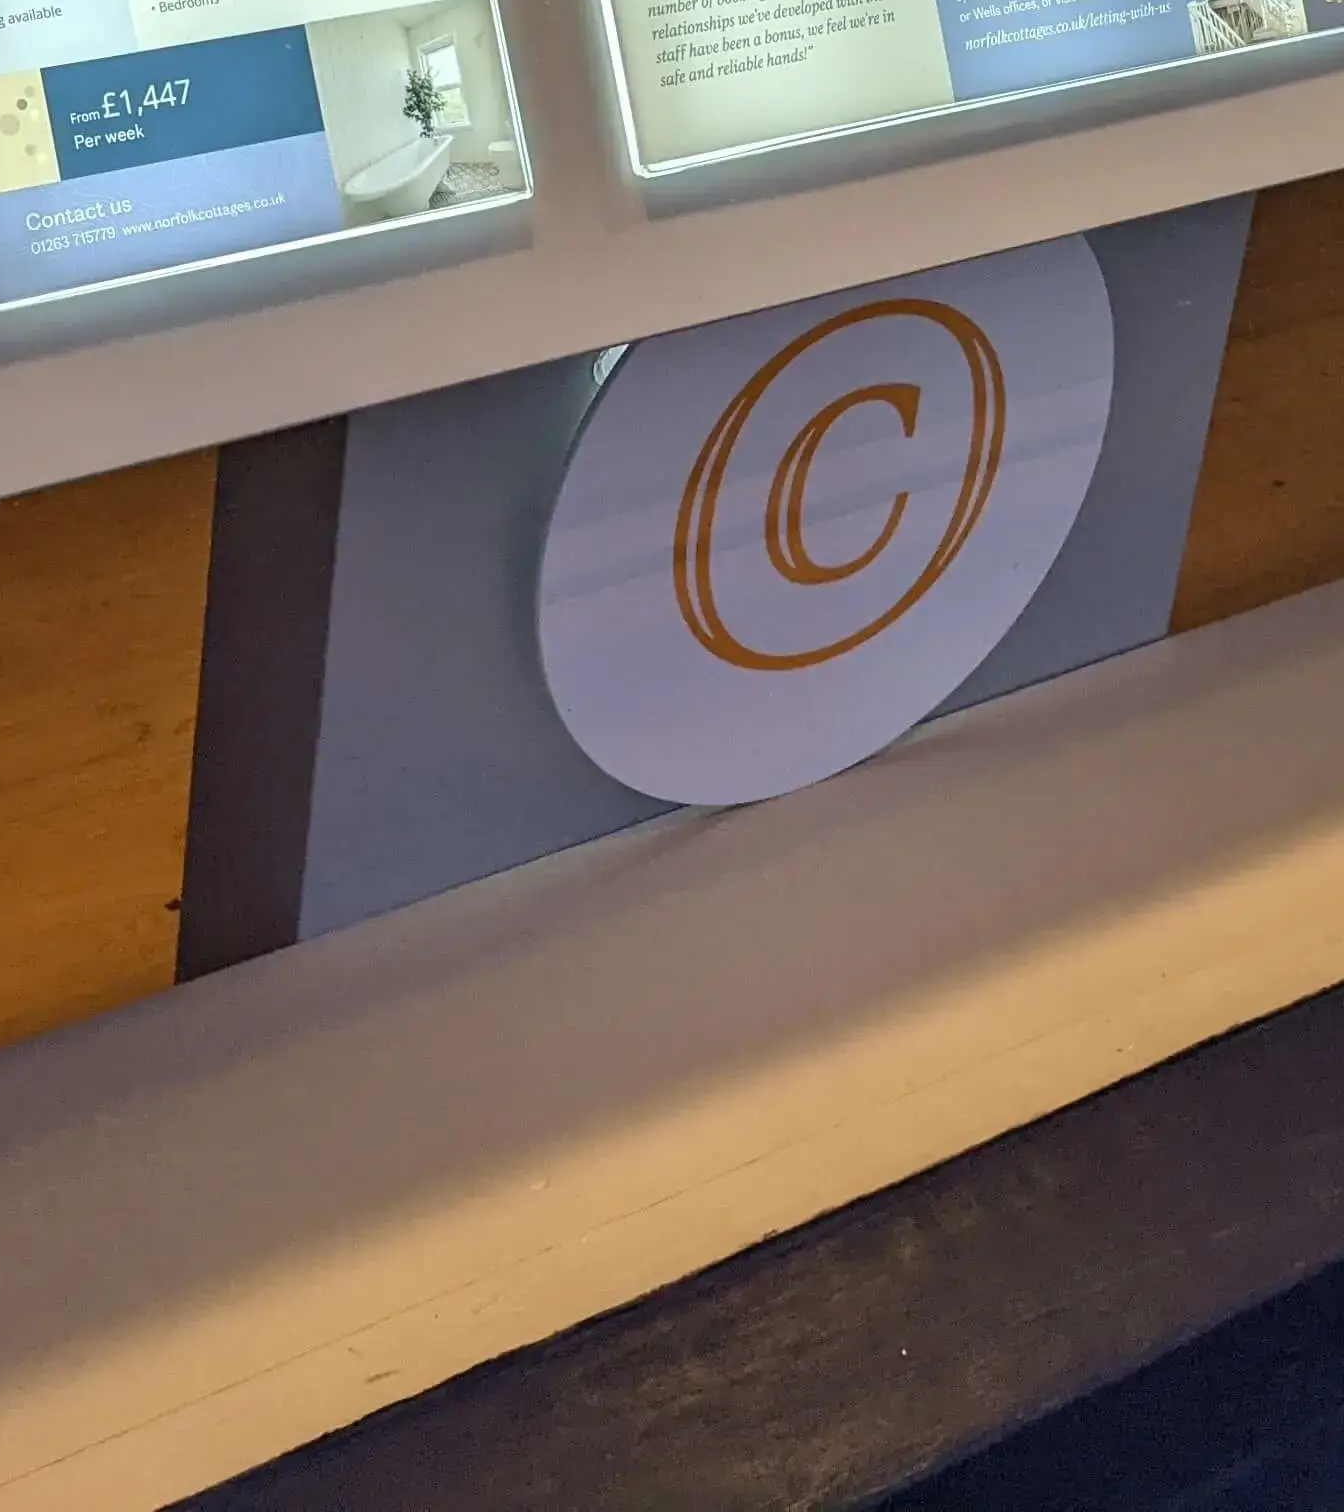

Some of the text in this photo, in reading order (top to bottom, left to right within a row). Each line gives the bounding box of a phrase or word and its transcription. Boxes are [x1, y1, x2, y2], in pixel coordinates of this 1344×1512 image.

[7, 5, 62, 24] available
[69, 78, 190, 124] From £1,447
[73, 123, 145, 150] Per week
[25, 199, 132, 231] Contact us
[30, 191, 286, 255] 01263 715779 www.norfolkcottages.co.uk
